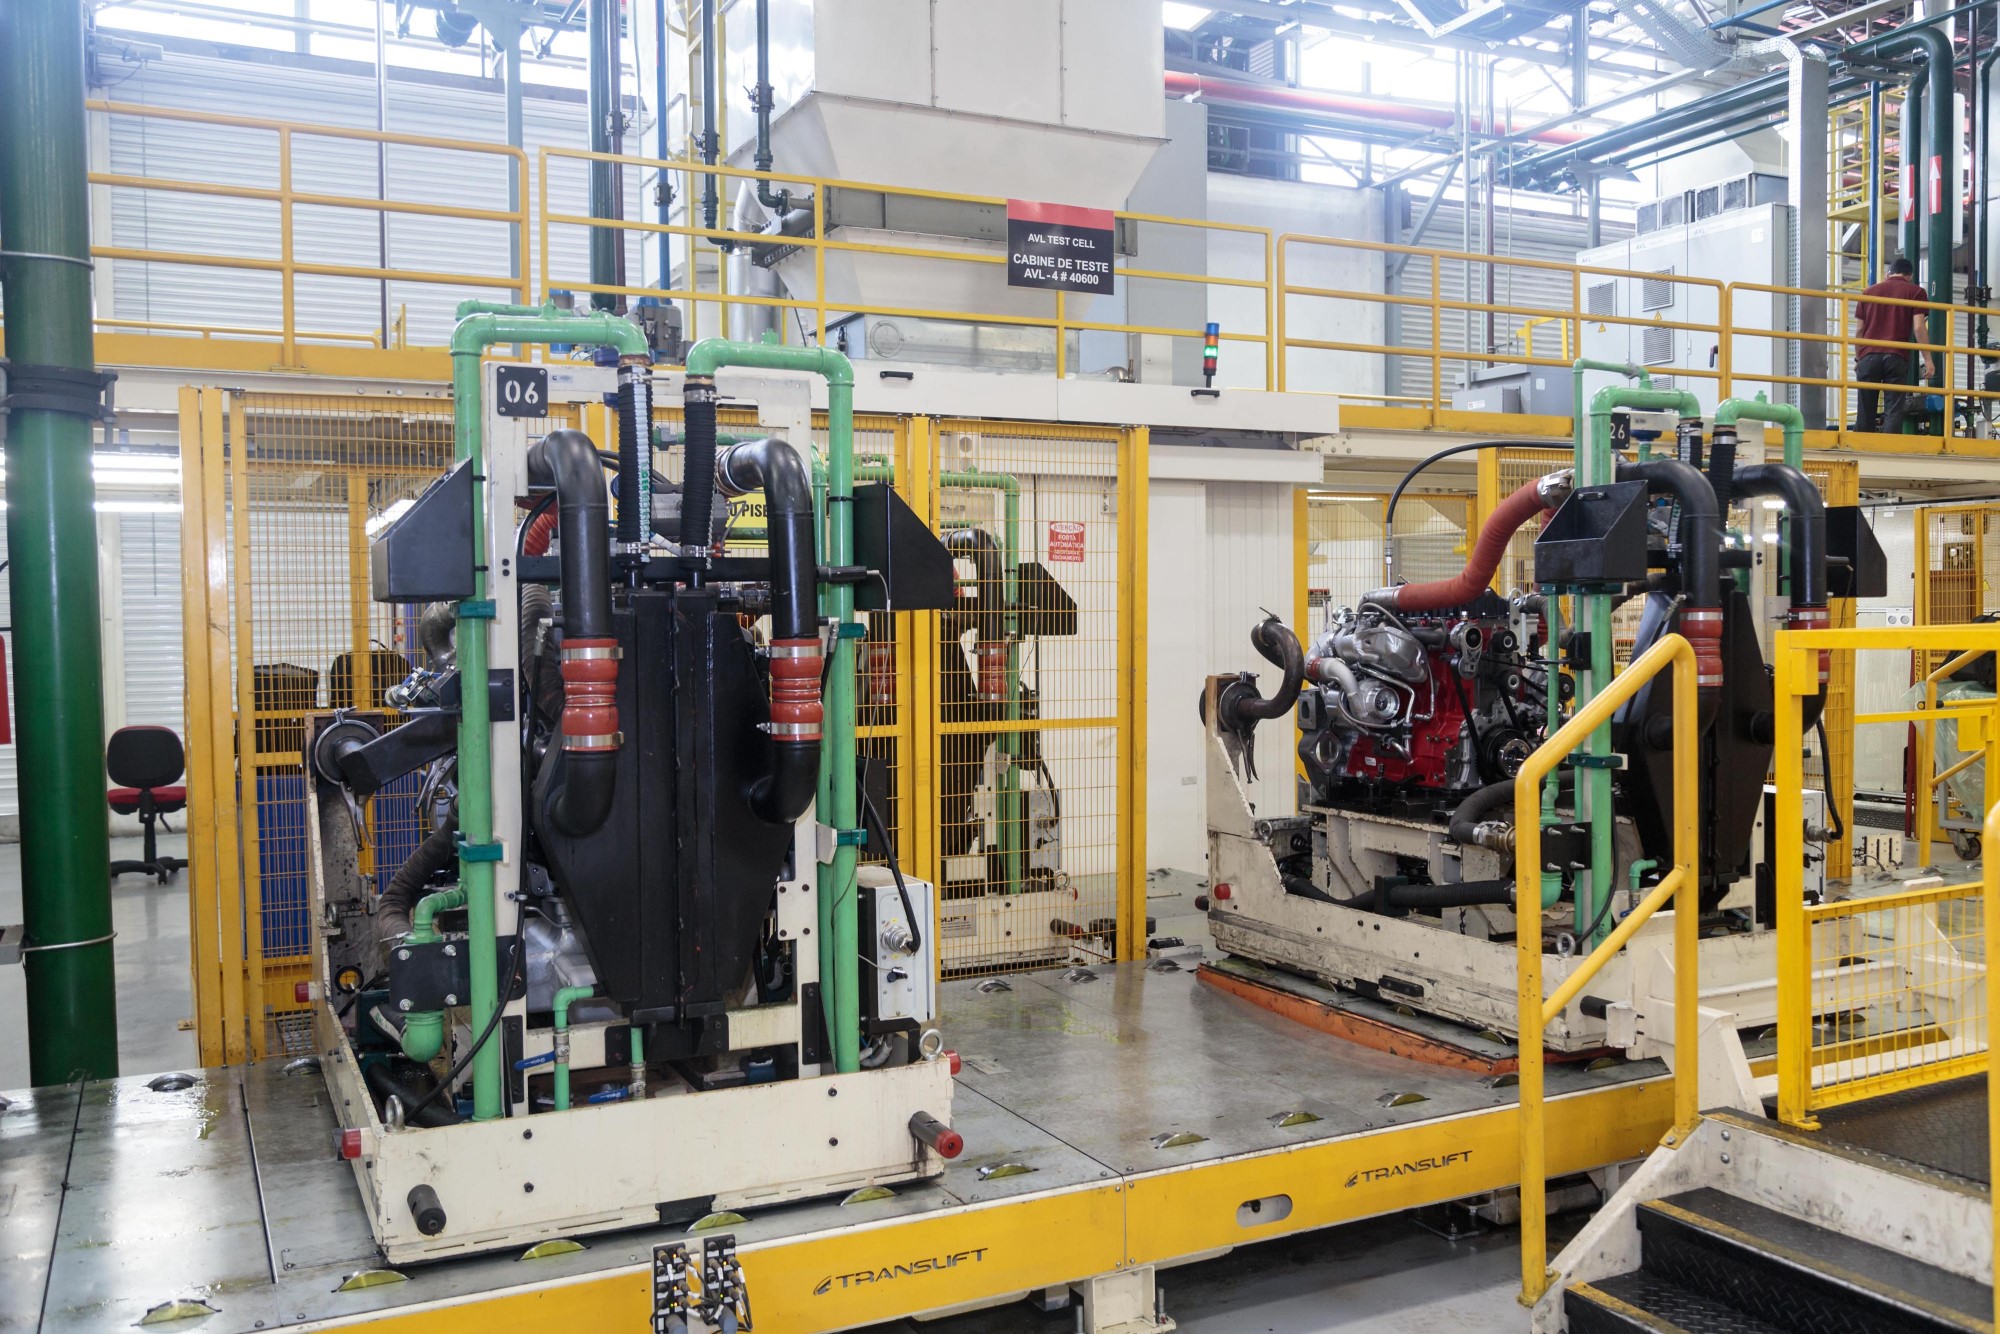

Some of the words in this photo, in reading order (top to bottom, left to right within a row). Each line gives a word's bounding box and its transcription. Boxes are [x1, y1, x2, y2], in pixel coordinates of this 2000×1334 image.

[1027, 233, 1046, 243] AVL
[1047, 235, 1071, 246] TEST
[1072, 238, 1096, 249] CELL
[1013, 253, 1055, 268] CABINE
[1057, 258, 1073, 269] DE
[1075, 260, 1109, 273] TESTE
[1069, 272, 1099, 285] 40600
[505, 380, 539, 404] 06
[1610, 422, 1626, 440] 26
[1361, 1150, 1473, 1182] TRANSLIFT
[835, 1247, 989, 1289] TRANSLIFT
